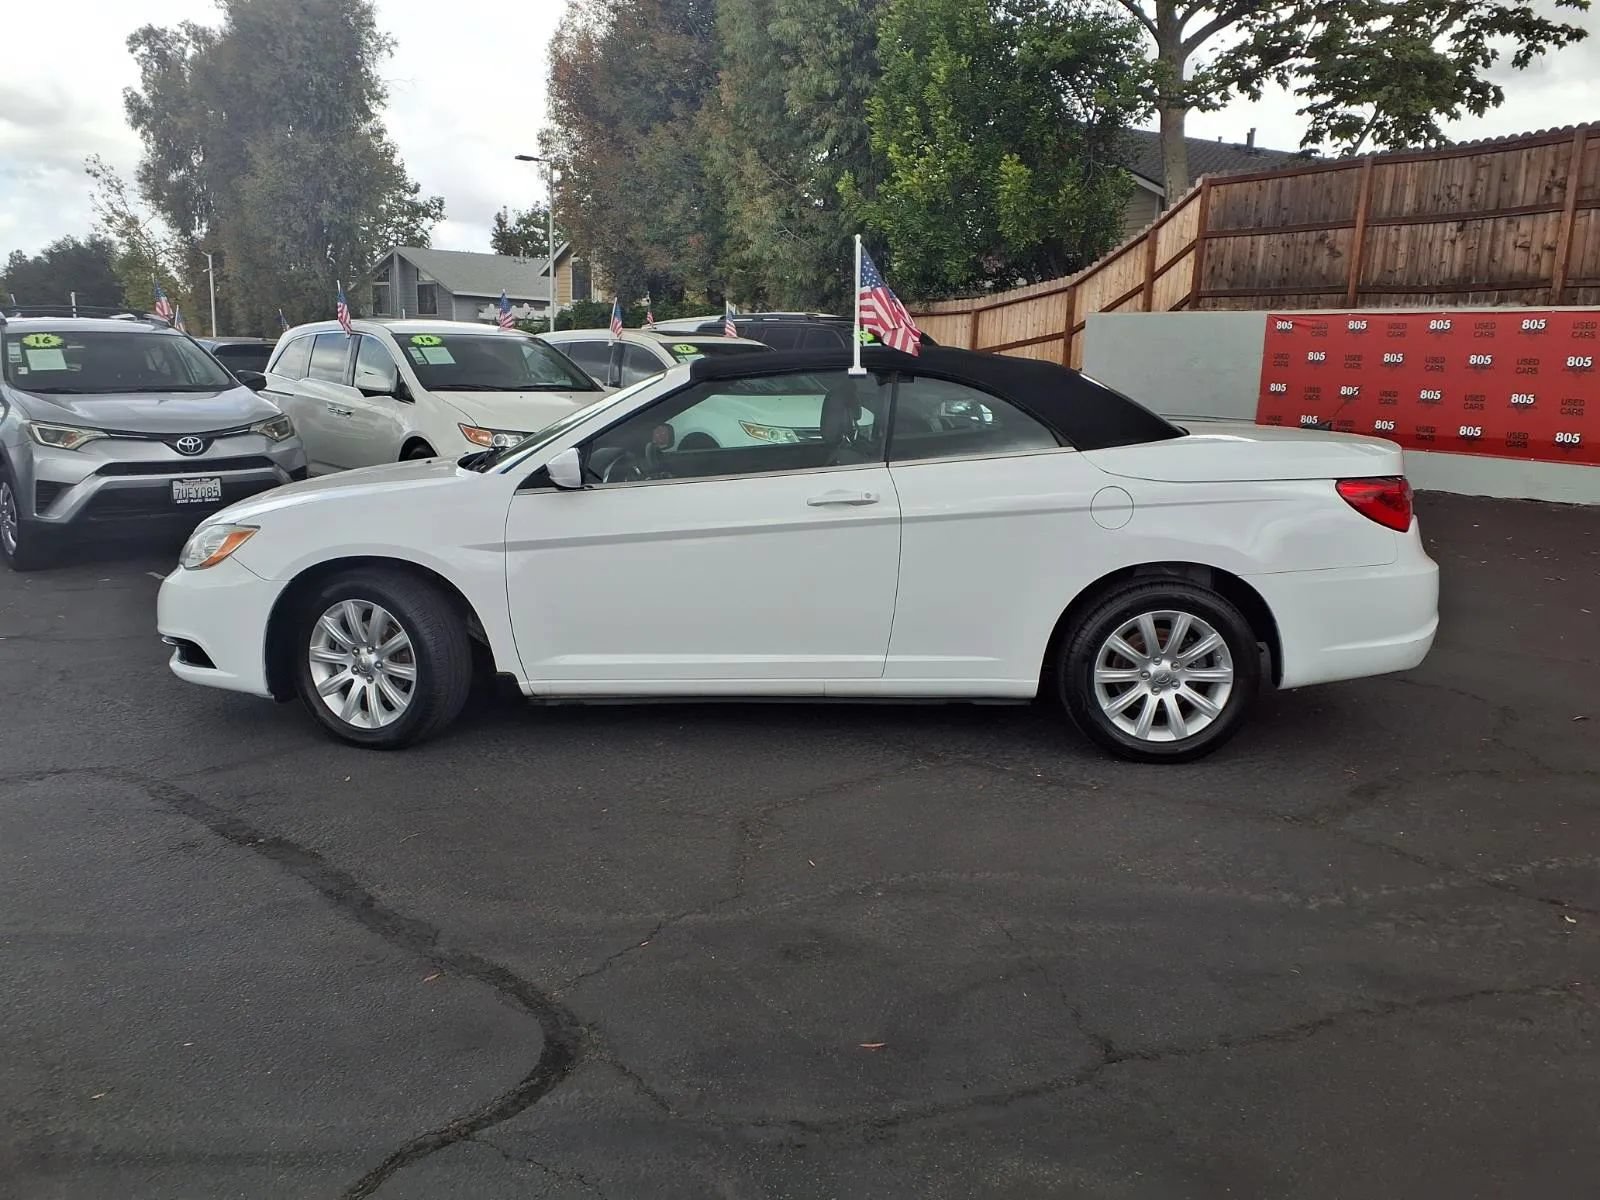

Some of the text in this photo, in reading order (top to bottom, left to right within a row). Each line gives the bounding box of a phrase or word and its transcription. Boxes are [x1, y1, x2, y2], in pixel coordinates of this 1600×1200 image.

[1276, 321, 1293, 330] 805
[1348, 320, 1368, 330] 805
[1387, 322, 1407, 330] USED
[1429, 320, 1451, 330] 805
[1474, 322, 1496, 330] USED
[1521, 319, 1547, 330] 805
[1573, 321, 1598, 329] USED
[1571, 331, 1596, 339] CARS
[35, 336, 52, 344] 16
[1307, 351, 1326, 361] 805
[1383, 353, 1404, 363] 805
[1469, 354, 1493, 365] 805
[1516, 358, 1540, 366] USED
[1566, 356, 1593, 367] 805
[1424, 364, 1444, 372] CARS
[1515, 367, 1539, 375] CARS
[1270, 383, 1287, 392] 805
[1340, 386, 1360, 395] 805
[1379, 390, 1399, 398] USED
[1420, 389, 1442, 400] 805
[1464, 394, 1486, 402] USED
[1510, 393, 1535, 404] 805
[1561, 398, 1585, 407] USED
[1560, 408, 1585, 416] CARS
[1300, 415, 1319, 424] 805
[1374, 420, 1395, 430] 805
[1459, 426, 1482, 436] 805
[1506, 431, 1529, 440] USED
[1555, 432, 1581, 444] 805
[1505, 440, 1528, 449] CARS
